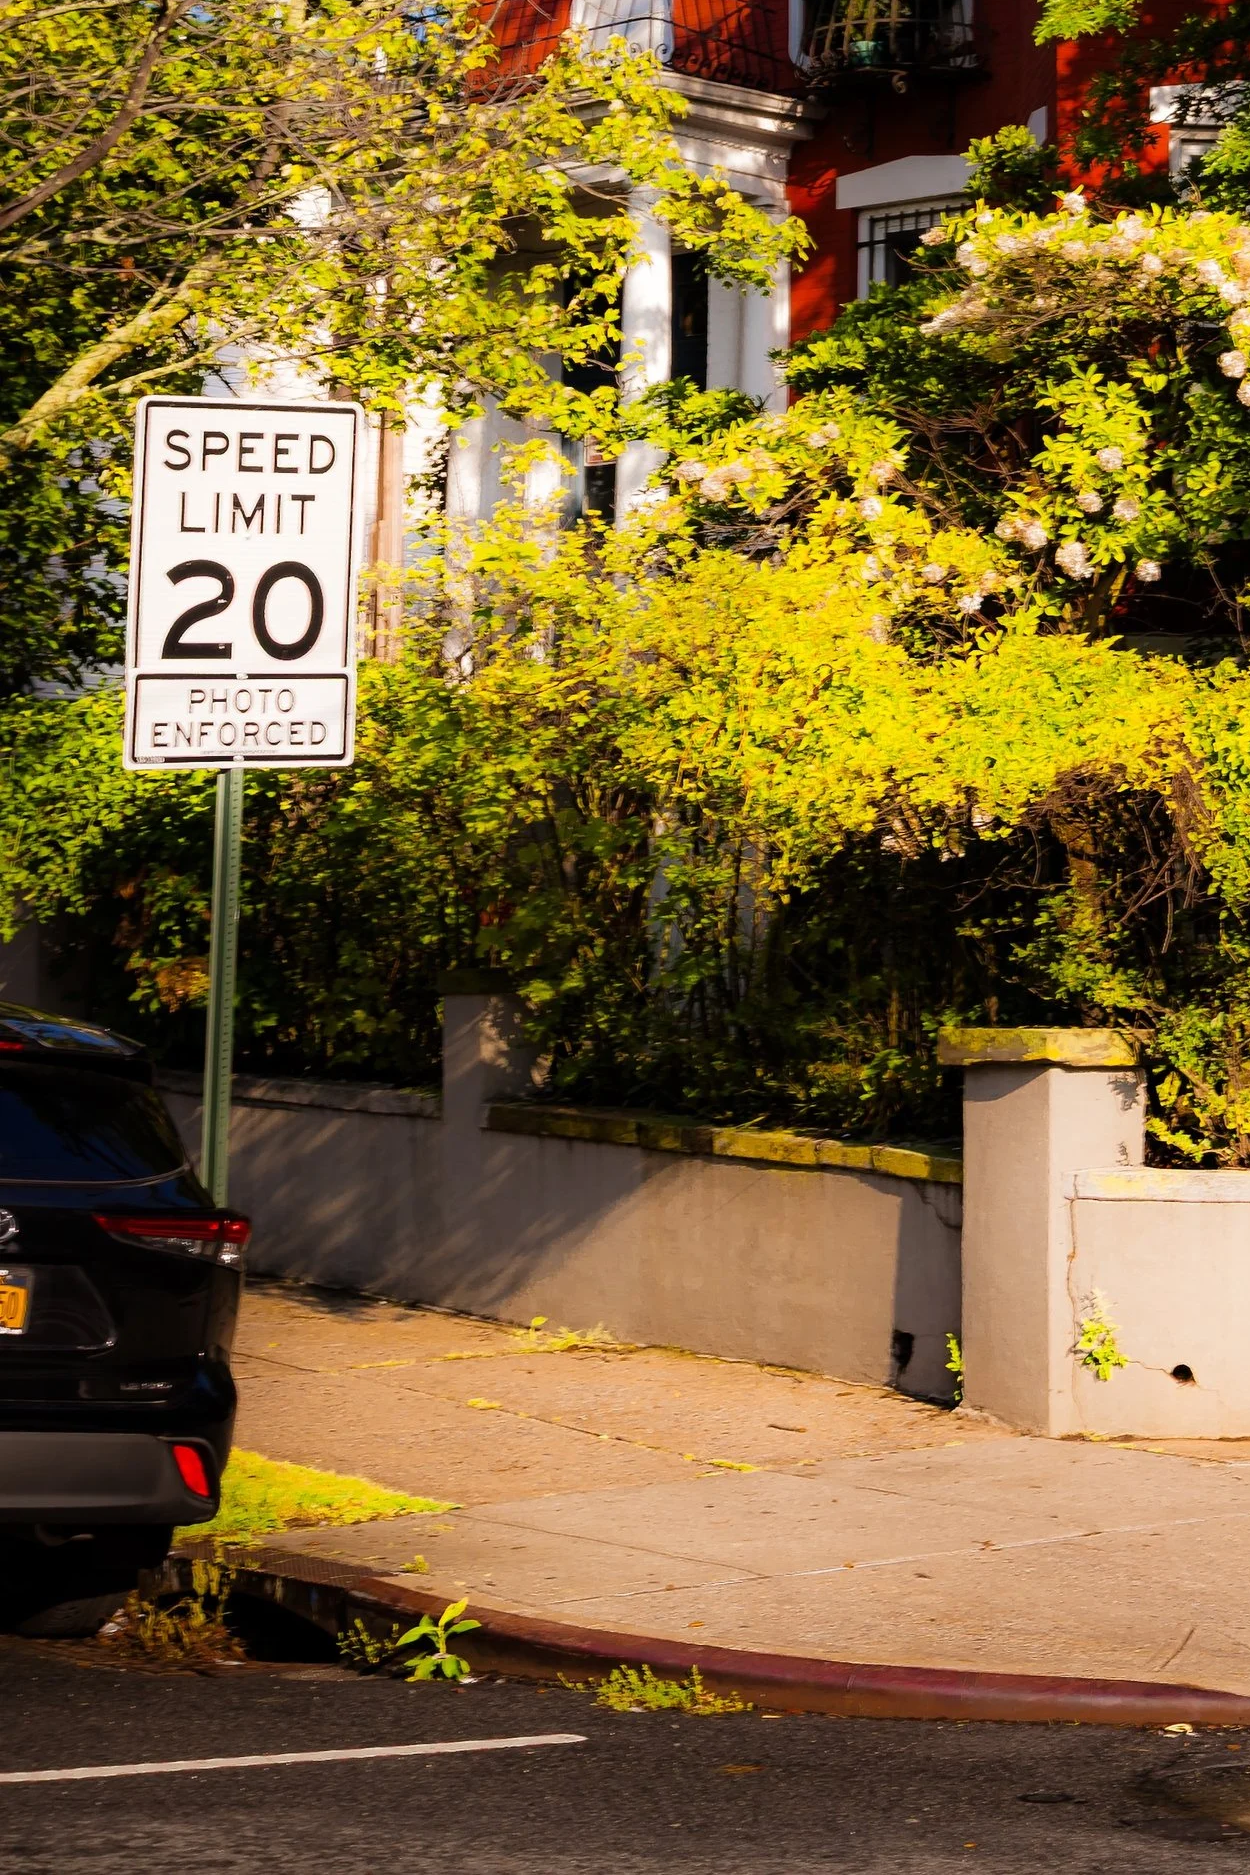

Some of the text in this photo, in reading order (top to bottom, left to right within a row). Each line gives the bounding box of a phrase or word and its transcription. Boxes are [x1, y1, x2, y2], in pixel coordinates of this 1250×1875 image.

[163, 429, 336, 474] SPEED
[180, 491, 316, 535] LIMIT
[161, 559, 324, 661] 20
[189, 688, 296, 714] PHOTO
[150, 721, 328, 748] ENFORCED
